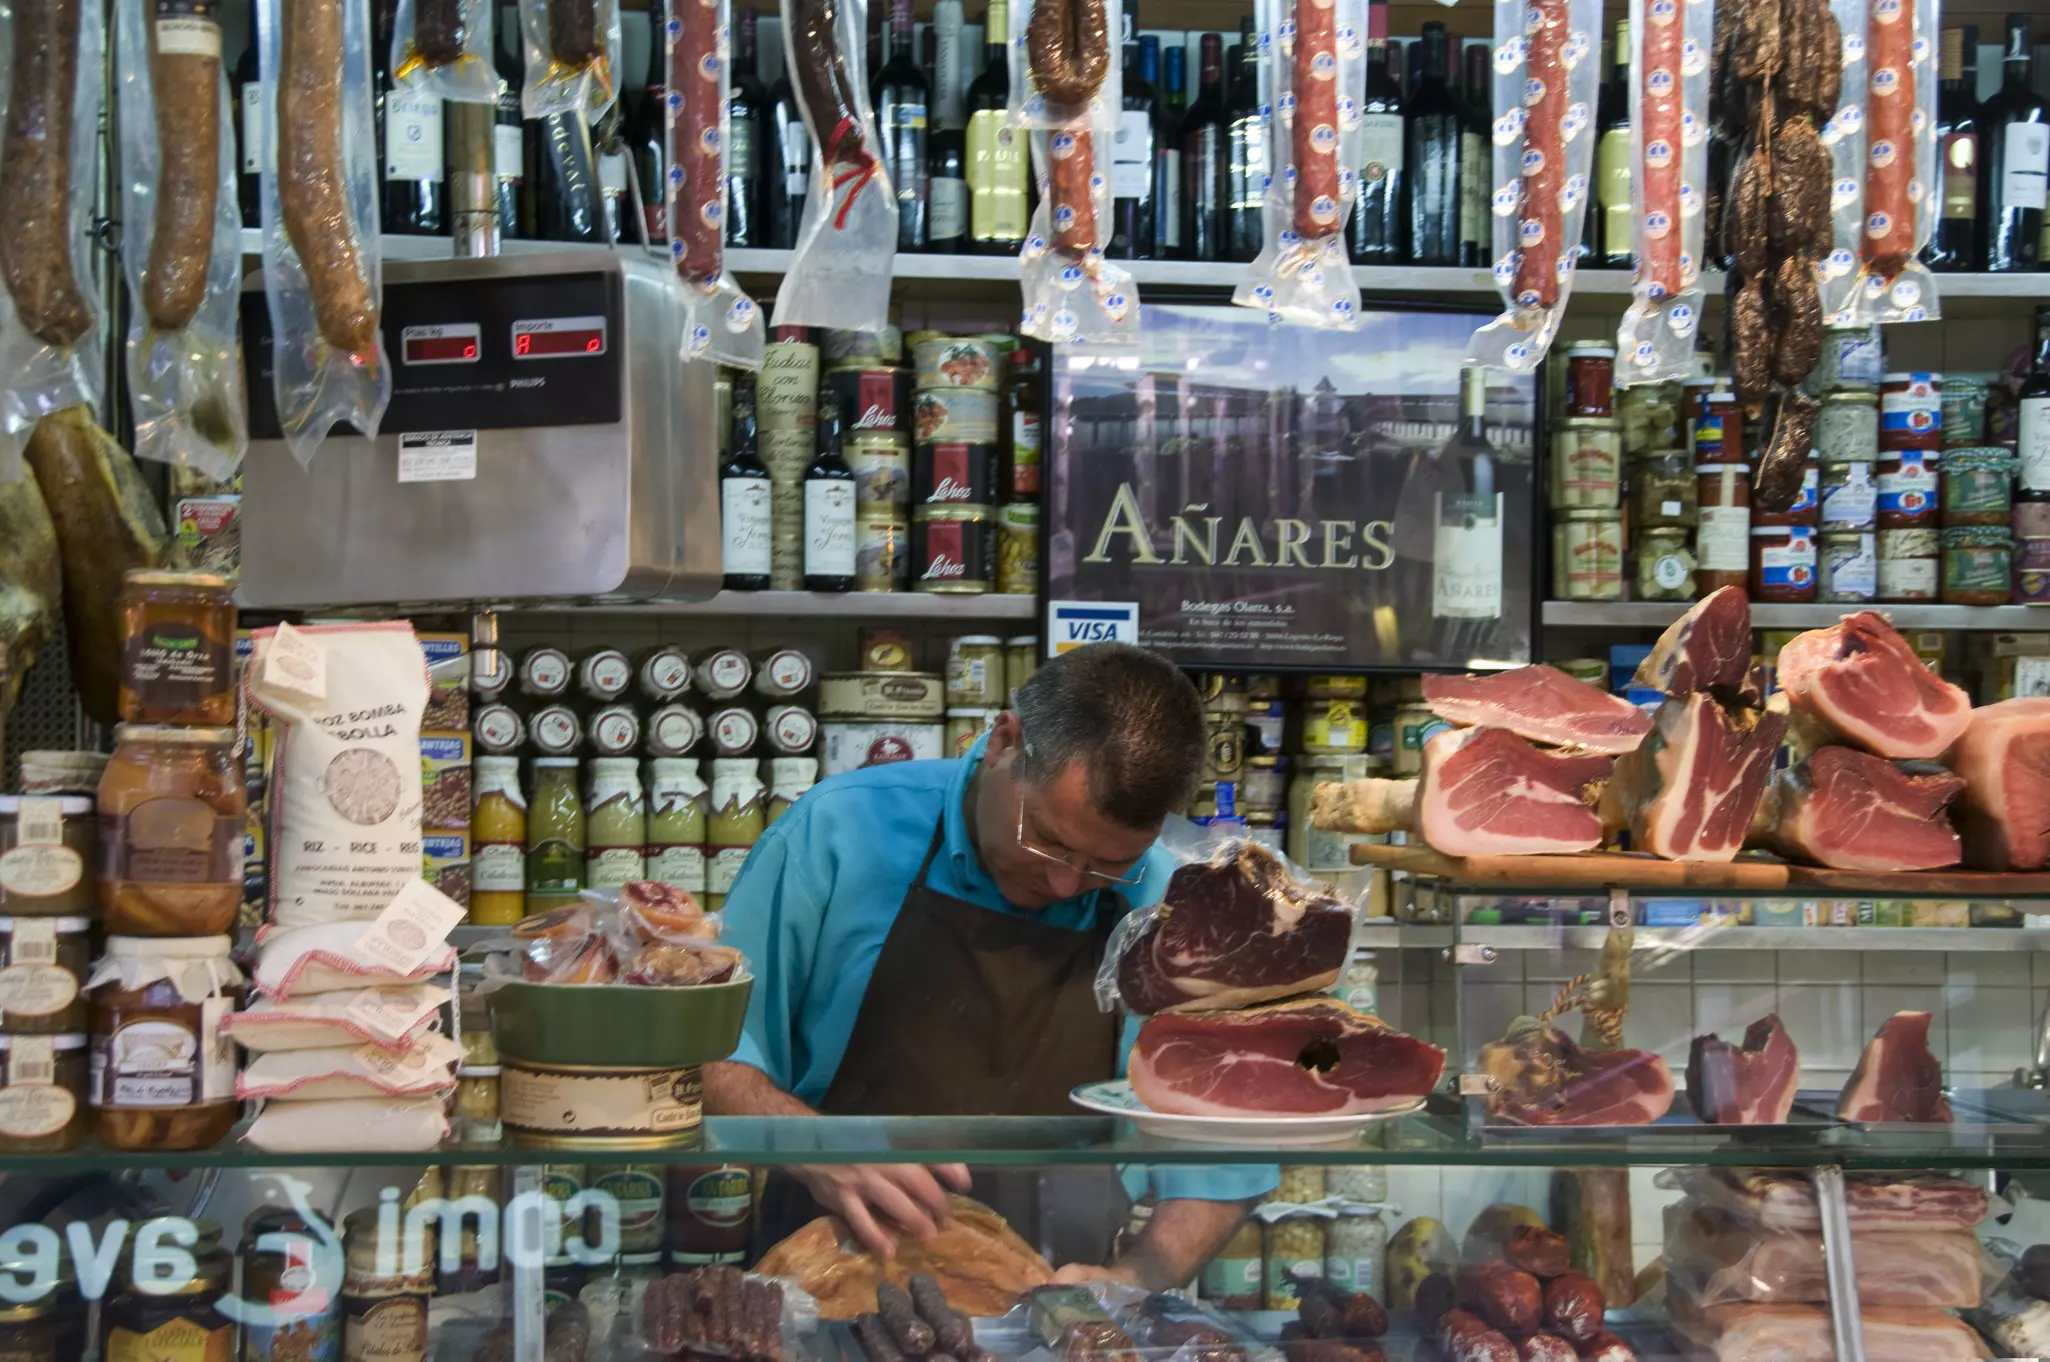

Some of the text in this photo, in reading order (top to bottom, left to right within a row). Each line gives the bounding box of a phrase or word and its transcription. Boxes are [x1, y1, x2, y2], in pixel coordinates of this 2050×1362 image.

[509, 377, 546, 388] PHILIPS
[926, 477, 972, 503] Lahoz
[1083, 481, 1396, 571] AÑARES
[921, 554, 966, 580] Lahoz
[1181, 600, 1231, 614] Bodegas
[1068, 621, 1118, 641] VISA
[348, 703, 406, 721] BOMBA
[303, 841, 325, 852] RIZ
[350, 842, 377, 853] RICE
